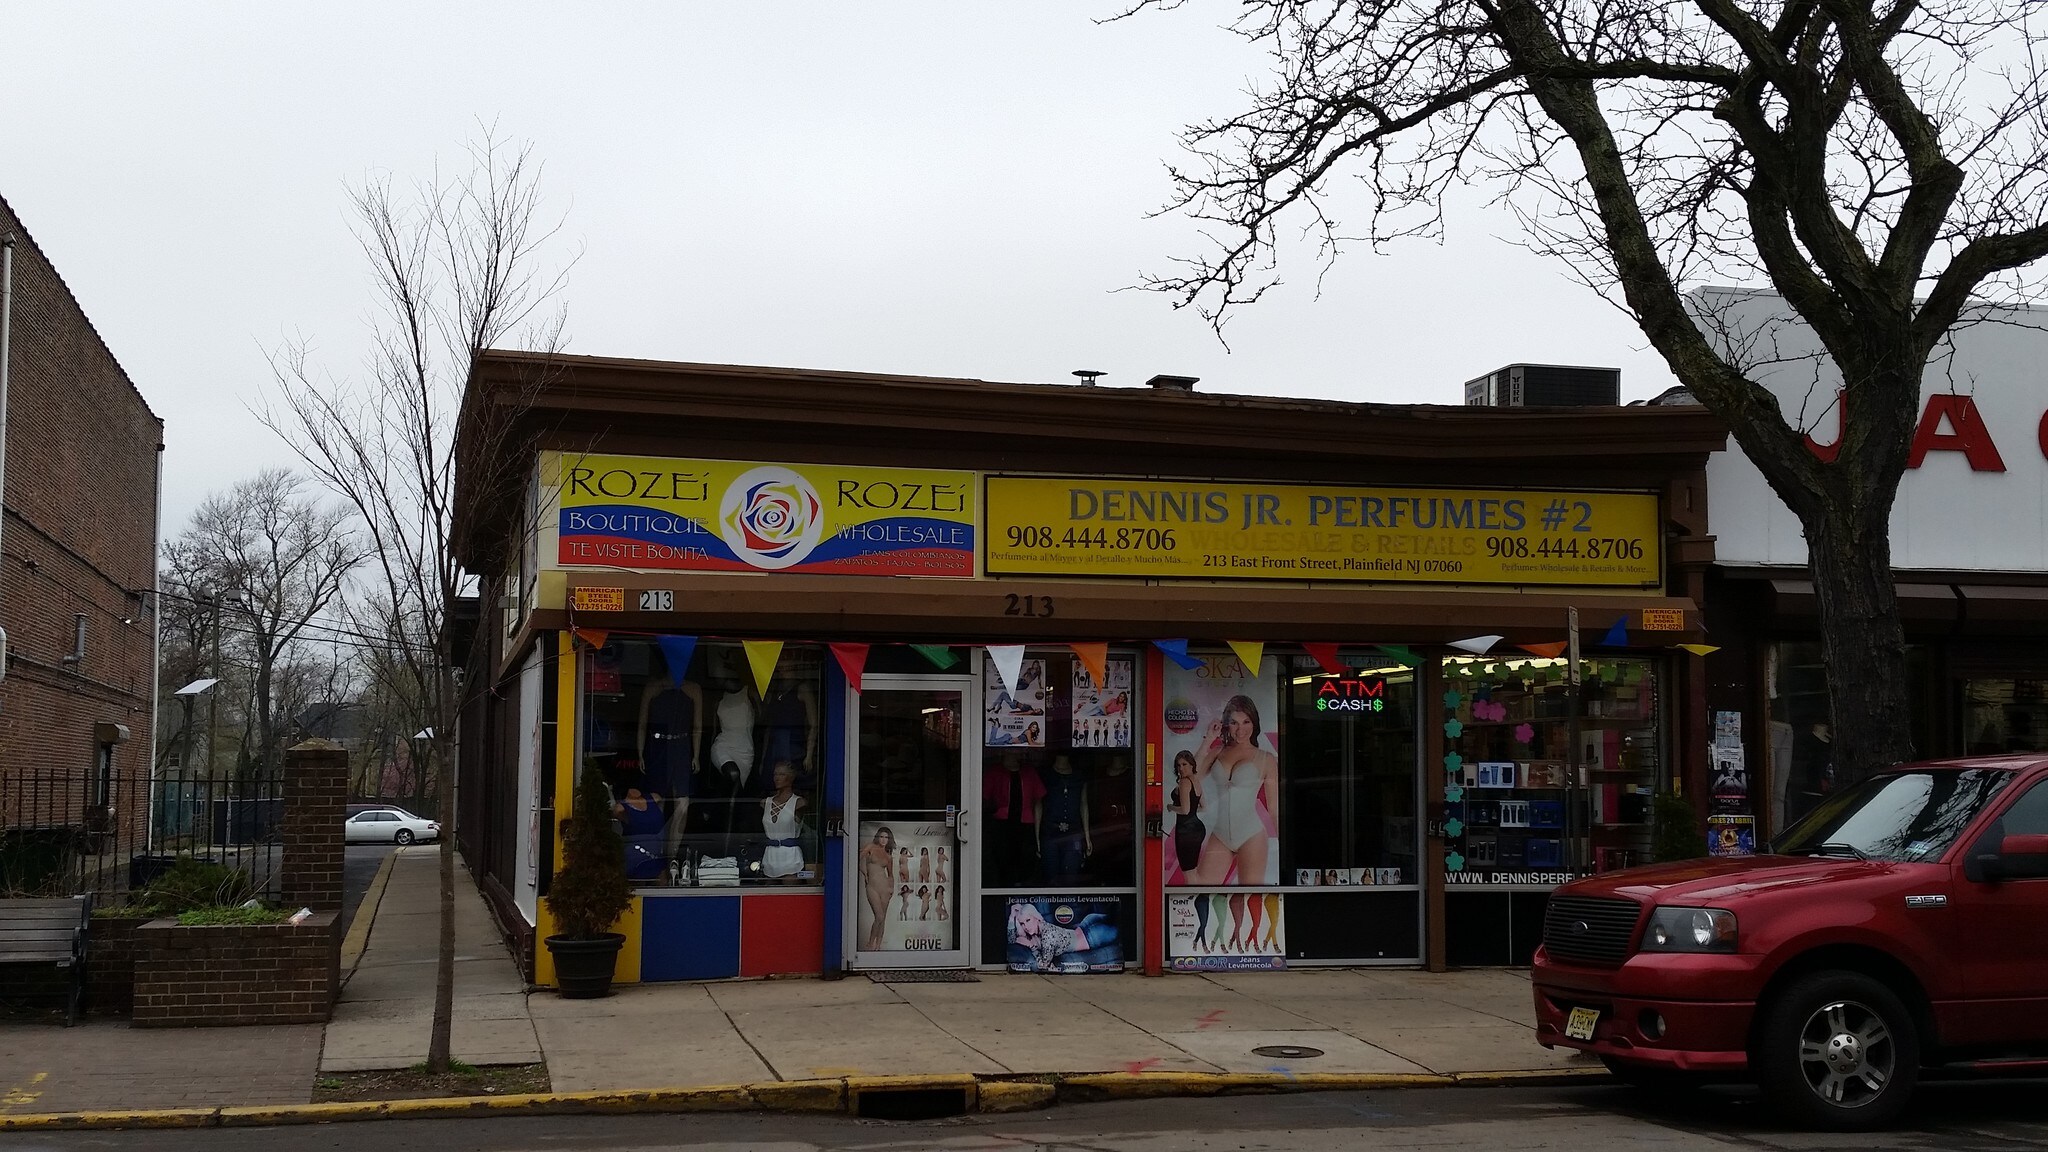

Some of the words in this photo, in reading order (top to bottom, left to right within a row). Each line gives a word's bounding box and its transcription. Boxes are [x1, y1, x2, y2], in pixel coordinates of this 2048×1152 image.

[1068, 488, 1230, 524] DENNIS
[1241, 493, 1293, 531] JR.
[1308, 495, 1526, 532] PERFUMES
[1540, 498, 1592, 532] #2
[569, 512, 709, 534] BOUTIQUE
[835, 523, 964, 544] WHOLESALE
[1007, 525, 1176, 550] 908.444.8706
[569, 542, 591, 557] TE
[595, 543, 642, 559] VISTE
[646, 545, 709, 561] BONITA
[1486, 536, 1643, 560] 908.444.8706
[1203, 554, 1227, 567] 213
[1231, 555, 1258, 568] East
[1262, 555, 1296, 568] Front
[1300, 557, 1342, 571] Street,
[1344, 558, 1402, 571] Plainfield
[1406, 559, 1420, 574] NJ
[1424, 559, 1463, 572] 07060
[1501, 563, 1537, 572] Perfumes
[1540, 563, 1579, 572] Wholesale
[641, 592, 672, 609] 213
[1005, 593, 1054, 617] 213
[1318, 680, 1384, 697] ATM
[1316, 697, 1384, 713] $CASH$
[1008, 896, 1028, 904] Jeans
[1077, 895, 1120, 903] Levantacola
[905, 939, 941, 950] CURVE
[1174, 957, 1228, 969] COLOR
